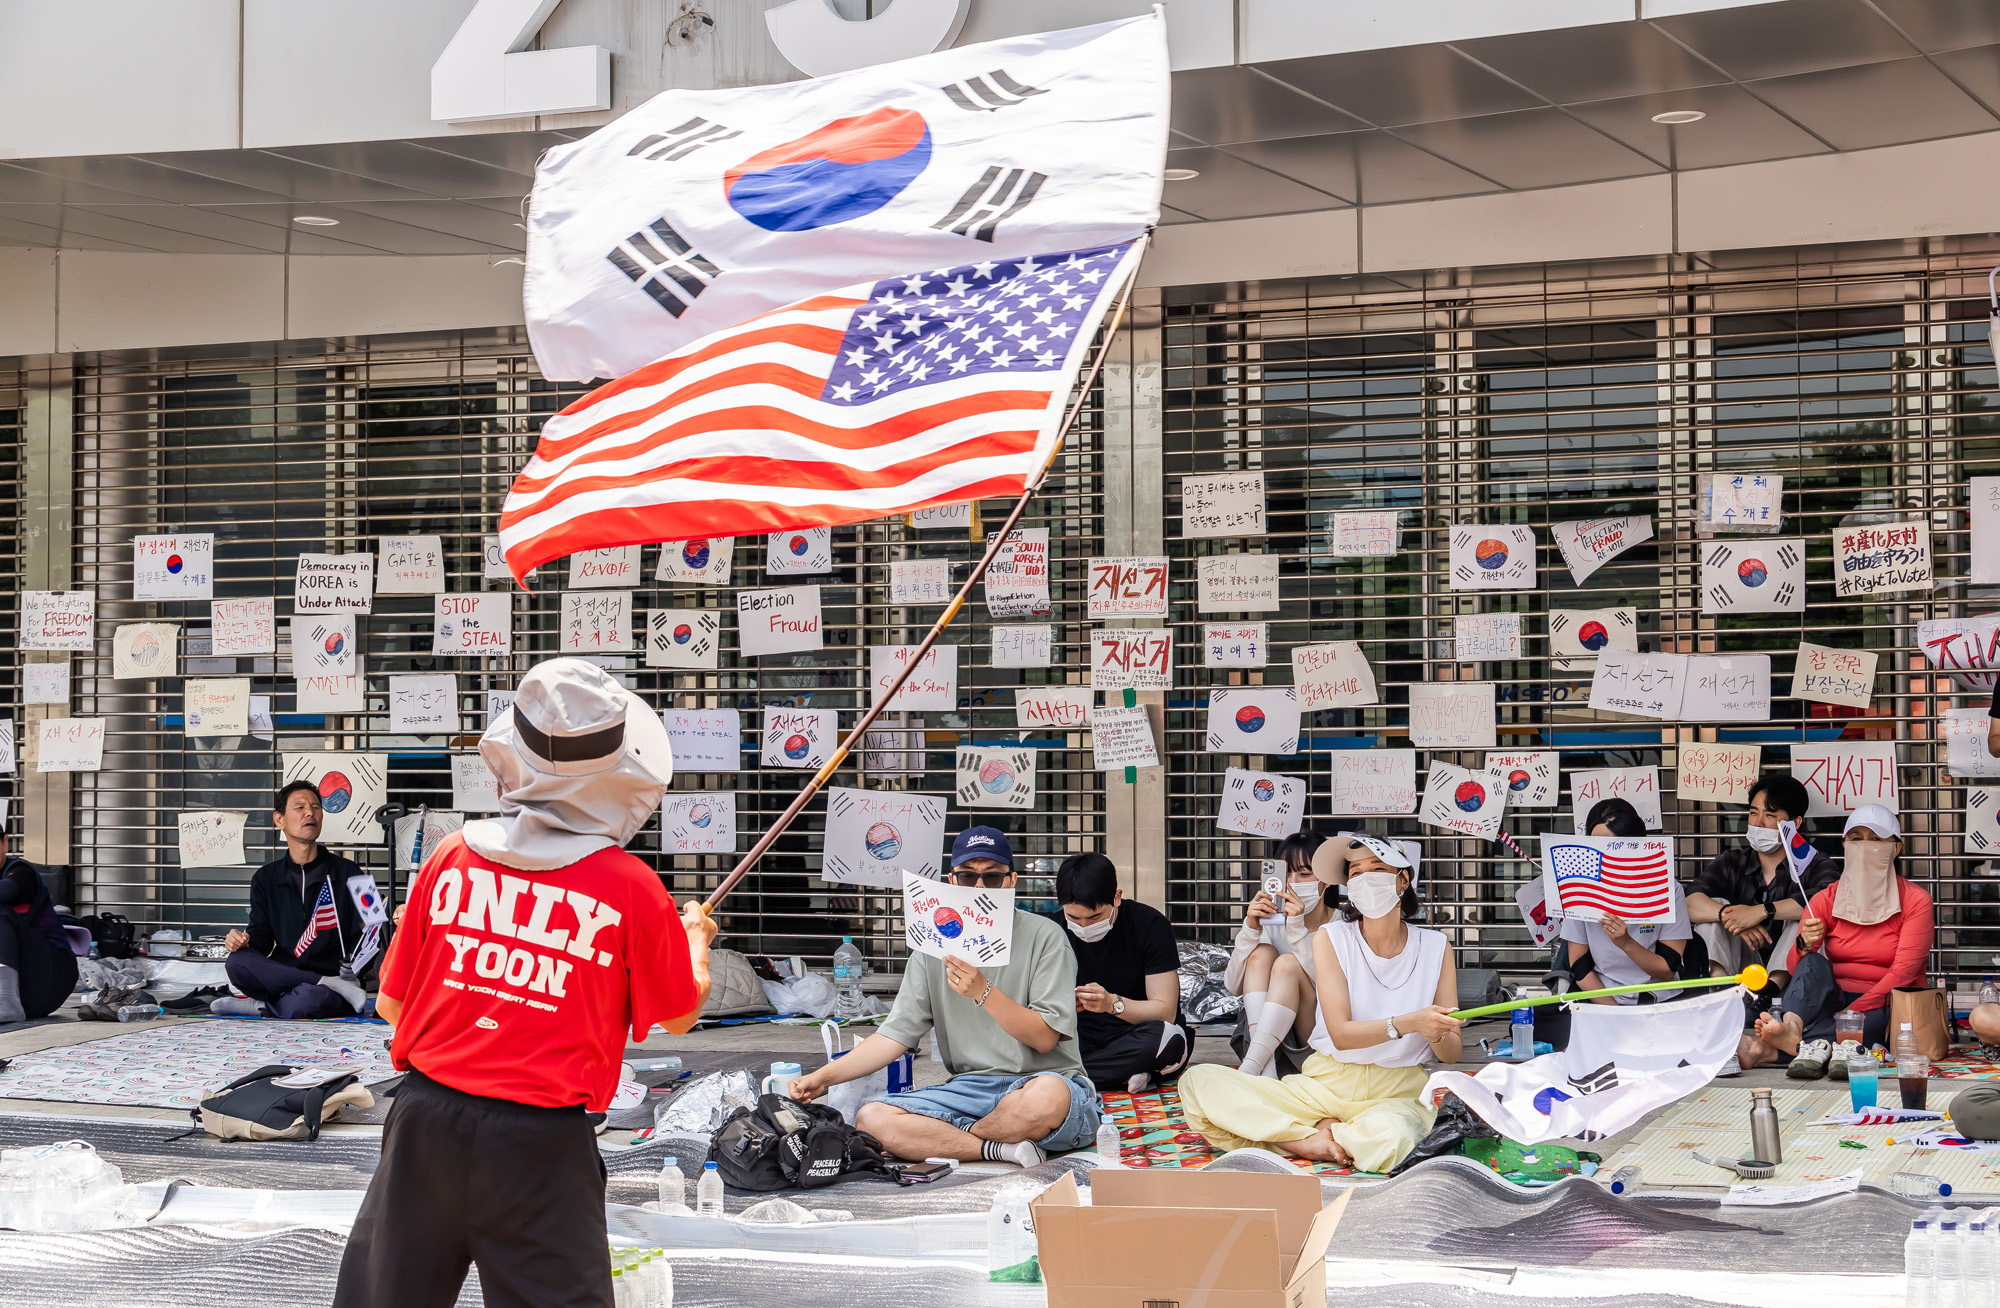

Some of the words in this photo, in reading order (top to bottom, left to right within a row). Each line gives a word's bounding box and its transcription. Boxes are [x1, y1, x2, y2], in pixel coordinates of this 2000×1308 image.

[1184, 486, 1204, 497] 이걸
[1208, 483, 1235, 493] 무시하는
[1239, 480, 1262, 493] 당신들
[1186, 501, 1216, 513] 나중에
[1723, 507, 1769, 524] 수개표
[138, 539, 177, 556] 부정선거
[183, 538, 209, 553] 재선거
[1015, 542, 1045, 552] SOUTH
[1592, 530, 1623, 553] FRAUD
[1596, 538, 1626, 561] RE-VOTE
[1842, 527, 1917, 554] 共産化反対
[301, 558, 357, 573] Democracy
[360, 561, 370, 570] in
[388, 553, 421, 567] GATE
[426, 552, 436, 567] 앞
[1014, 554, 1043, 564] KOREA
[1203, 559, 1238, 576] 국민이
[1843, 548, 1925, 572] 自由を守ろう!
[138, 571, 169, 585] 당일투표
[181, 574, 208, 586] 수개표
[300, 575, 344, 589] KOREA
[349, 578, 358, 587] is
[896, 565, 945, 583] 부정선거
[1093, 563, 1167, 601] 재선거
[1480, 570, 1505, 581] 재선거
[25, 597, 38, 610] We
[42, 598, 55, 609] Are
[57, 597, 90, 612] Fighting
[299, 595, 333, 608] Under
[335, 596, 372, 609] Attack!
[740, 593, 794, 611] Election
[1209, 591, 1232, 601] 재선거
[440, 598, 480, 615] STOP
[569, 597, 622, 617] 부정선거
[28, 616, 40, 626] For
[213, 621, 249, 637] 부정선거
[462, 618, 480, 628] the
[770, 614, 818, 633] Fraud
[27, 629, 39, 638] For
[461, 631, 506, 647] STEAL
[568, 630, 621, 647] 수개표
[1208, 629, 1231, 640] 게이트
[995, 629, 1050, 660] 국회해산
[1101, 635, 1170, 675] 재선거
[1298, 649, 1336, 673] 언론에
[1809, 650, 1864, 675] 참정권
[1602, 664, 1675, 692] 재선거
[1700, 673, 1755, 697] 재선거
[1802, 675, 1871, 698] 보장하라
[909, 681, 921, 692] the
[923, 679, 949, 698] Steal
[1300, 677, 1363, 707] 알려주세요
[1500, 686, 1568, 702] KSPO
[396, 688, 447, 710] 재선거
[1606, 697, 1644, 708] 자유민주주의
[1021, 700, 1087, 726] 재선거
[675, 717, 724, 730] 재선거
[772, 713, 820, 734] 재선거
[44, 724, 102, 743] 재선거
[1713, 751, 1756, 774] 재선거
[1578, 773, 1652, 802] 재선거
[1683, 774, 1717, 794] 민주주의
[1794, 754, 1897, 810] 재선거
[679, 796, 716, 808] 부정선거
[858, 798, 913, 832] 재선거
[180, 817, 208, 835] 더이상
[1234, 814, 1285, 835] 재선거
[1446, 818, 1483, 834] 재선거
[676, 839, 714, 850] 재선거
[1606, 841, 1625, 850] STOP
[1627, 842, 1639, 850] THE
[1643, 841, 1668, 850] STEAL
[859, 859, 899, 874] 부정선거
[430, 868, 622, 967] ONLY.
[912, 897, 940, 914] 부정선거
[962, 906, 993, 927] 재선거
[963, 935, 989, 951] 수개표
[446, 934, 573, 998] YOON
[443, 978, 465, 990] MAKE
[467, 984, 496, 996] YOON
[496, 990, 526, 1004] GREAT
[526, 1000, 558, 1013] AGAIN
